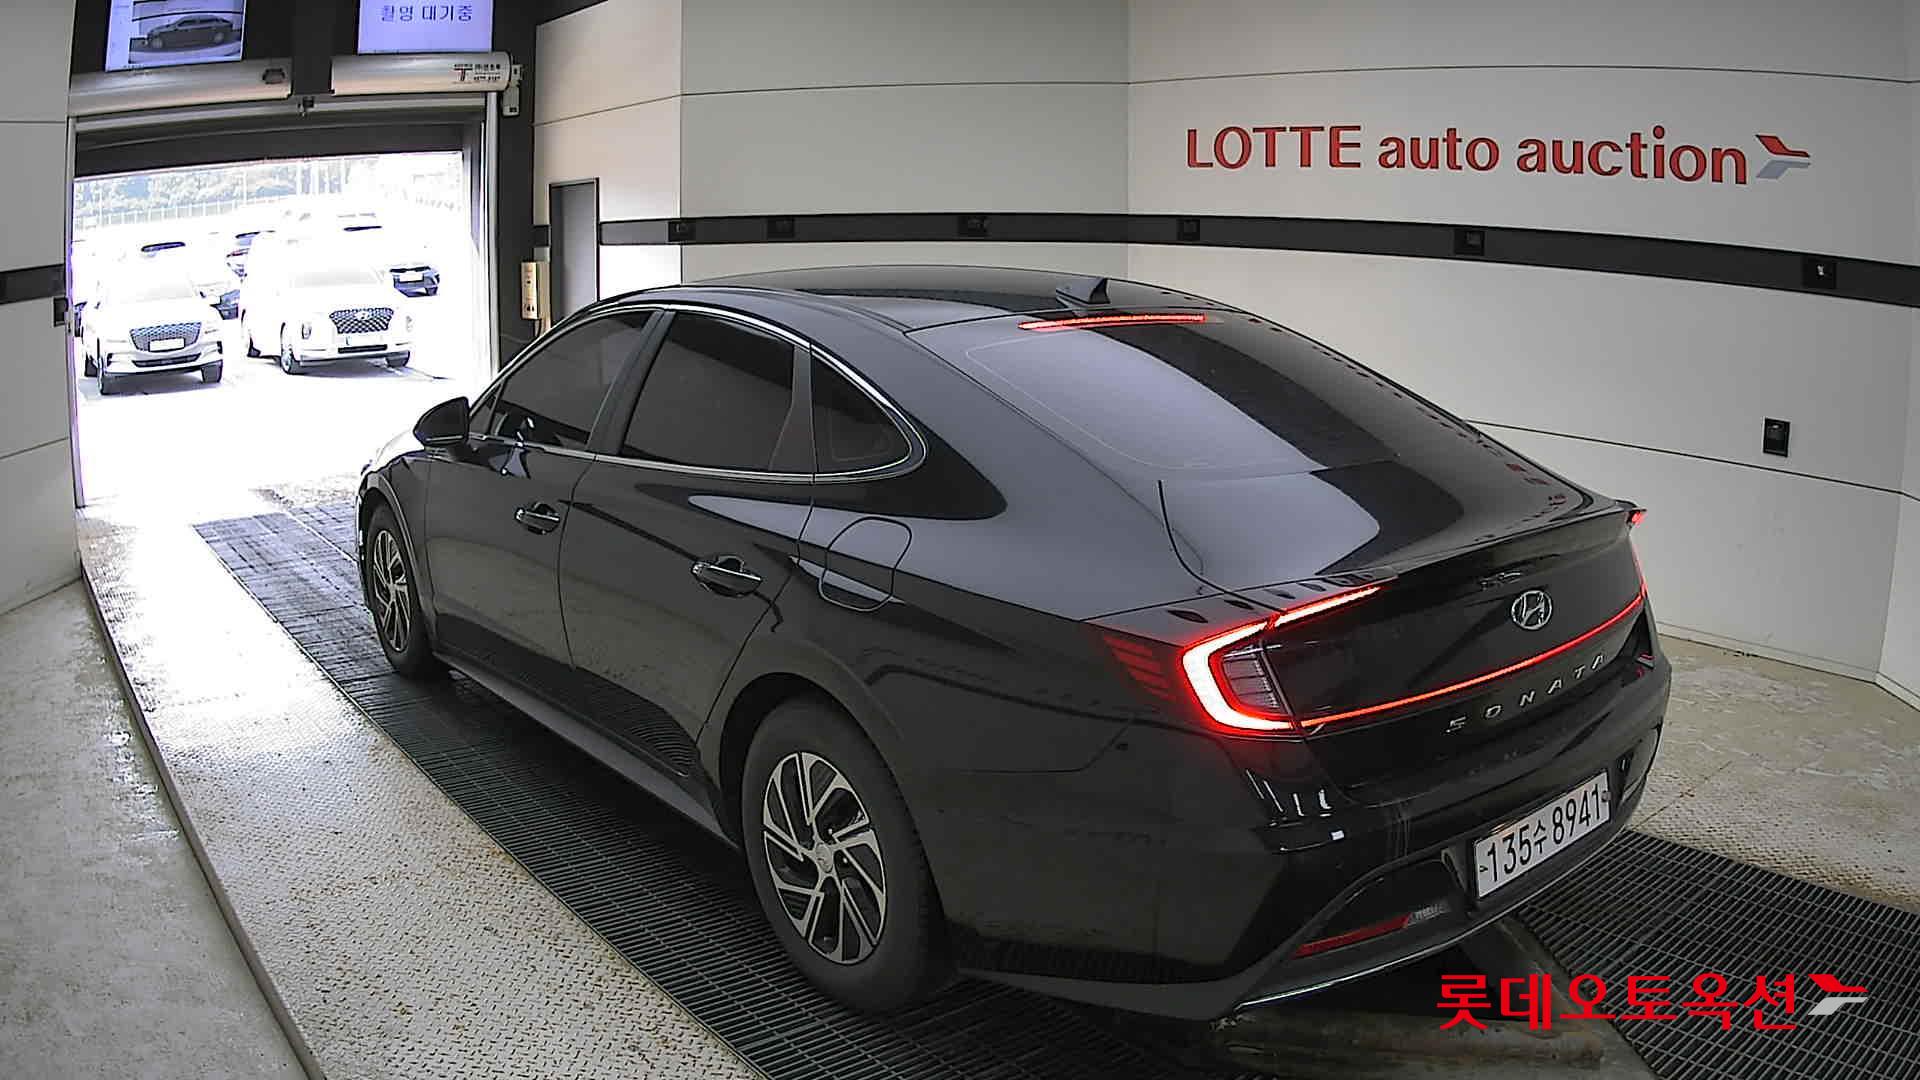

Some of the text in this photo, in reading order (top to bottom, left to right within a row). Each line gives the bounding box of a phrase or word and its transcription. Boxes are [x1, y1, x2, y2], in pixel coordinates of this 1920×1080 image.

[421, 4, 473, 22] 대기중
[1187, 125, 1748, 185] LOTTE auto auction
[1446, 654, 1606, 734] SONATA
